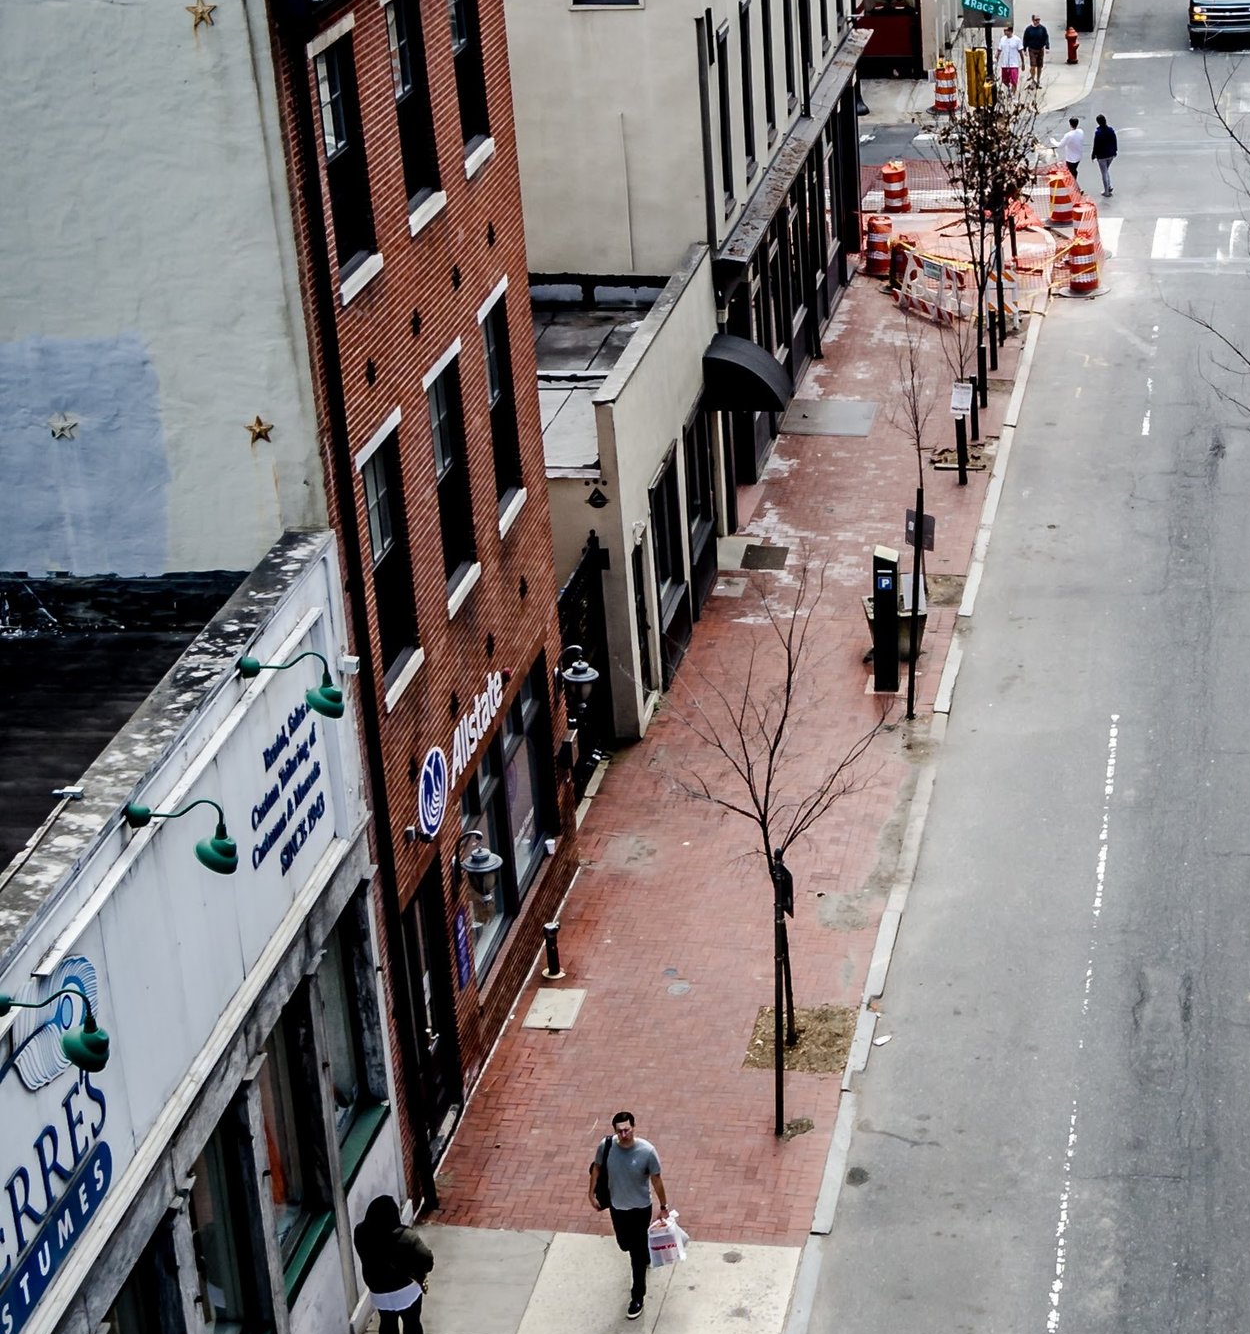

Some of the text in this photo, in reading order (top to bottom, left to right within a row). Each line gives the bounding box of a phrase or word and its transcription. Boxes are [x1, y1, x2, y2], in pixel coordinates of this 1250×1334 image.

[998, 5, 1008, 17] St
[881, 578, 890, 588] P
[450, 670, 503, 791] Allstate
